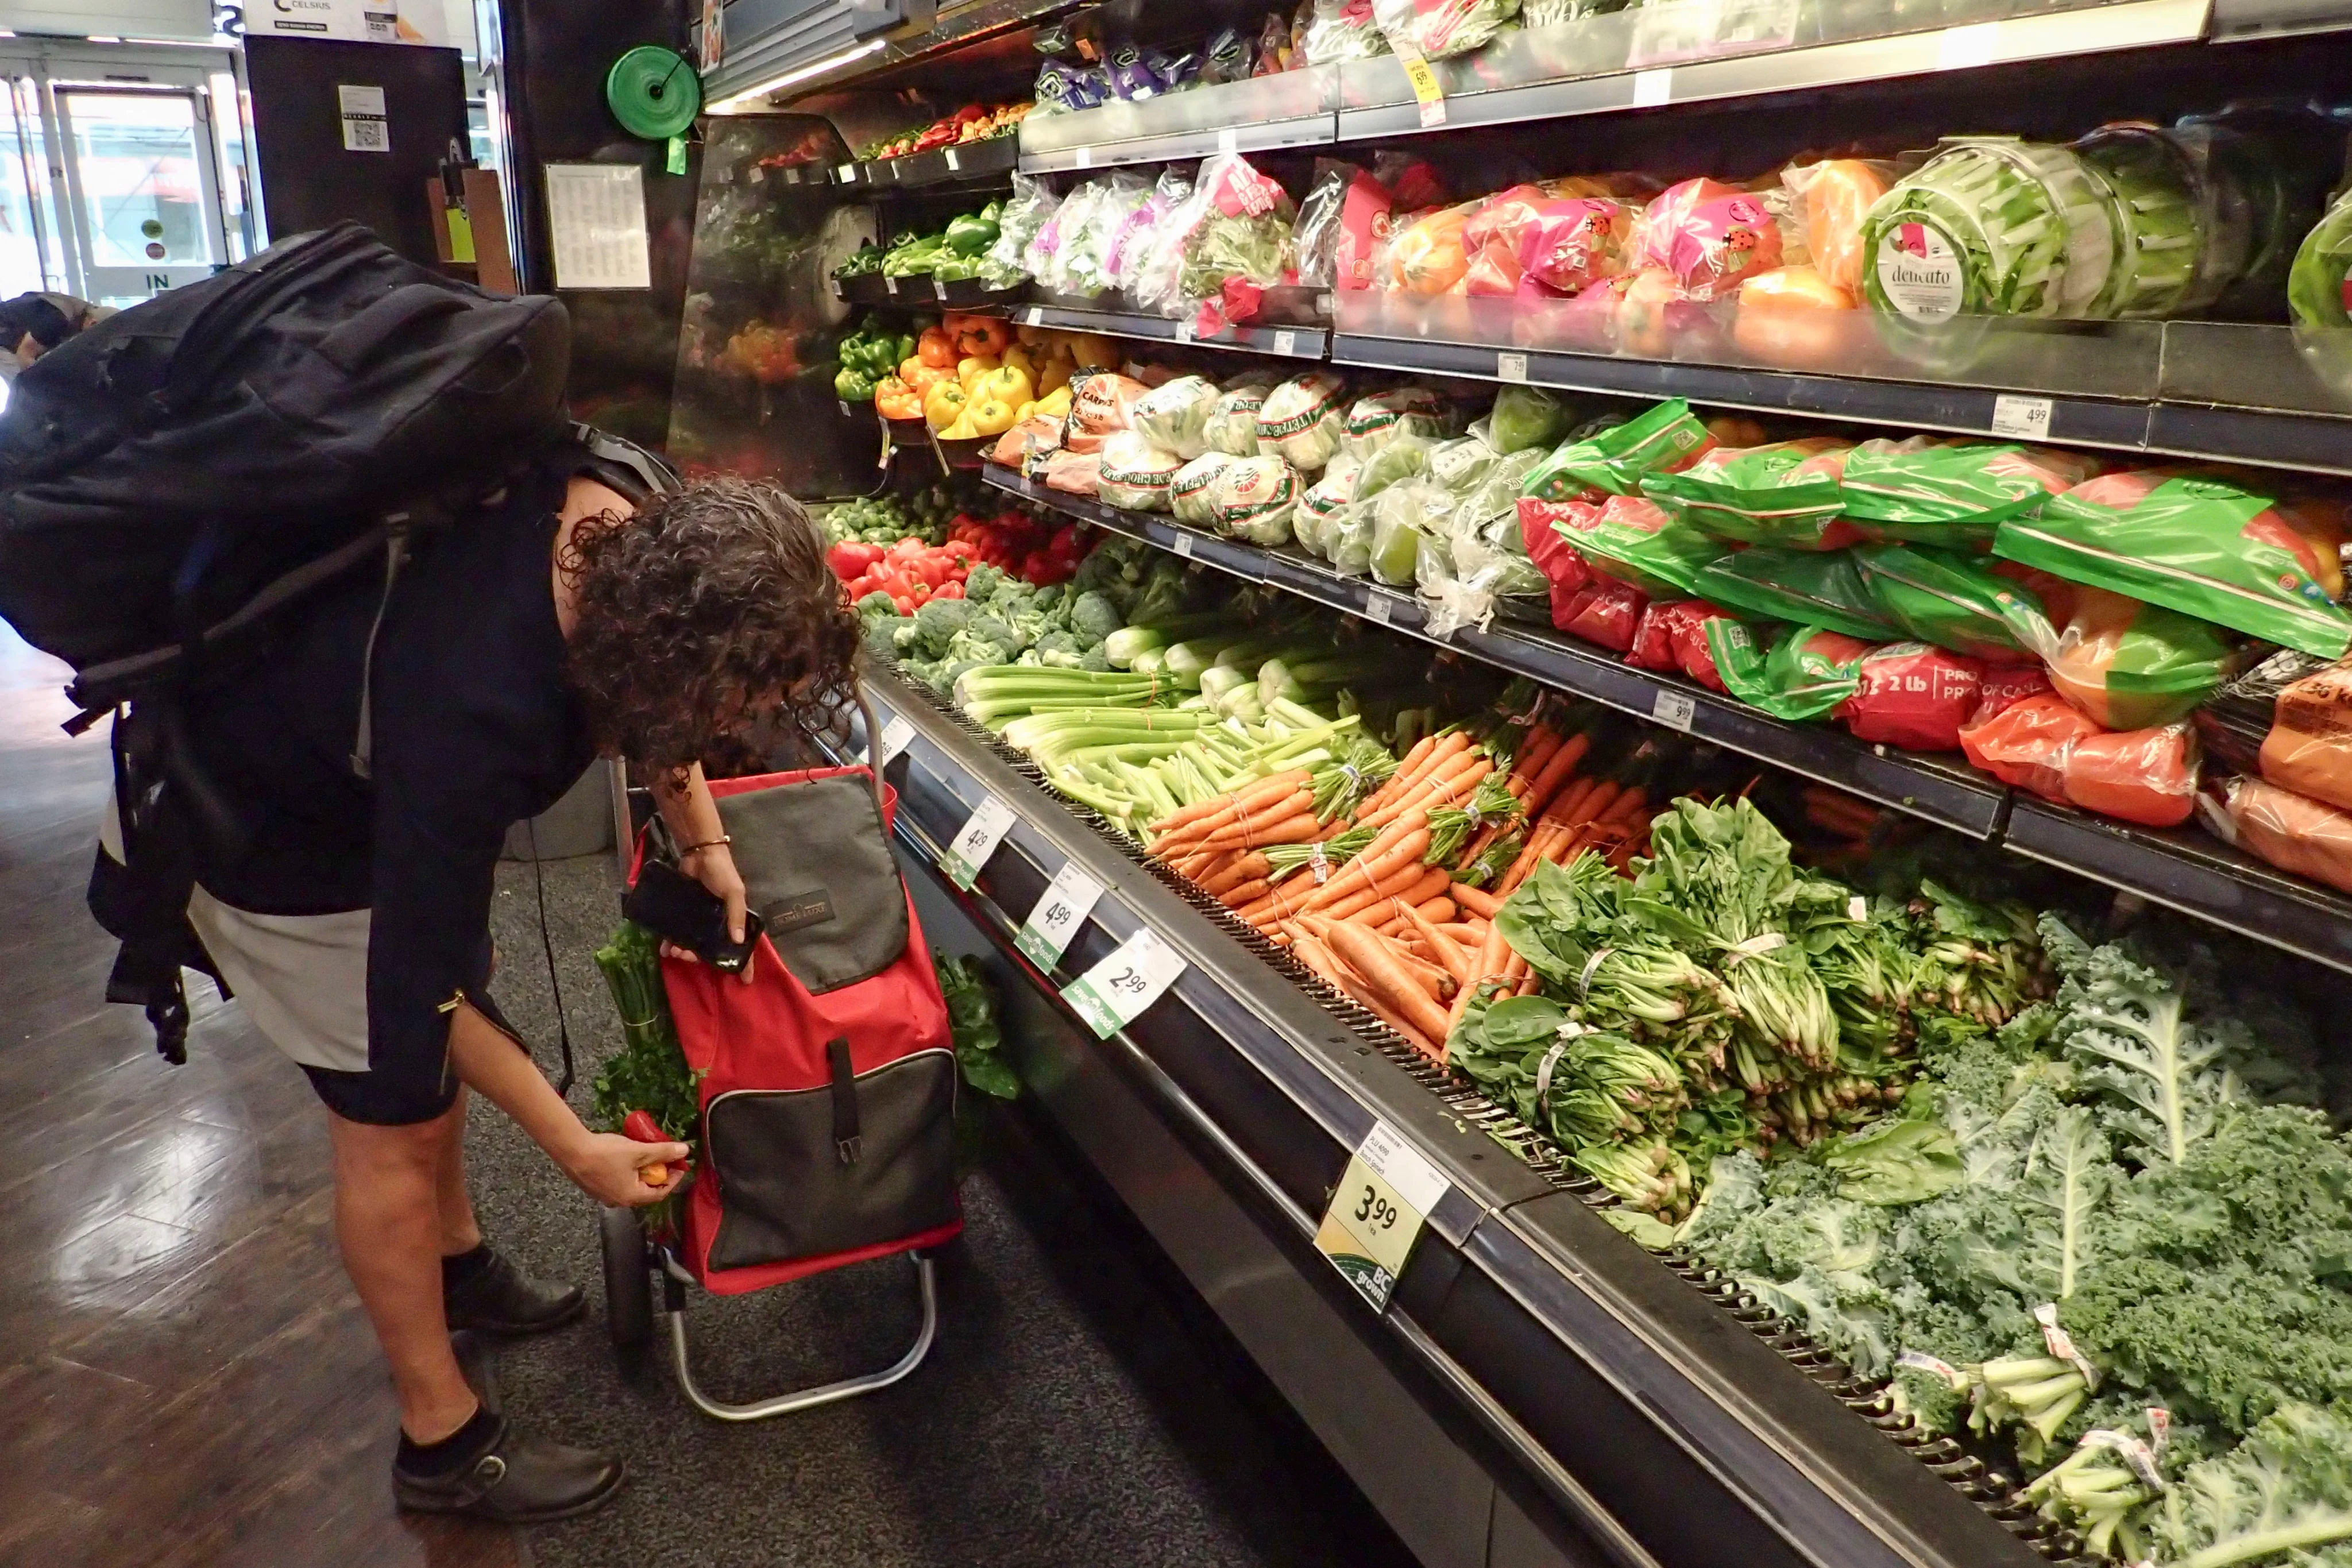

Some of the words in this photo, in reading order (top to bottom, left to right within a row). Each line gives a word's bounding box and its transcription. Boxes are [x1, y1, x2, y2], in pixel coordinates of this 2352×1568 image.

[292, 0, 330, 10] CELSIUS
[146, 275, 169, 289] IN
[2026, 408, 2046, 423] 499
[1888, 675, 1901, 692] 2
[1905, 675, 1927, 692] lb
[1677, 705, 1690, 717] 999
[967, 829, 988, 847] 429
[1045, 902, 1071, 925] 499
[1037, 944, 1054, 965] foods
[1109, 967, 1146, 993] 299
[1071, 985, 1089, 1005] save
[1095, 1006, 1115, 1030] foods
[1369, 1135, 1379, 1148] PLU
[1354, 1184, 1397, 1230] 399
[1357, 1270, 1385, 1303] grown
[1373, 1266, 1392, 1292] BC
